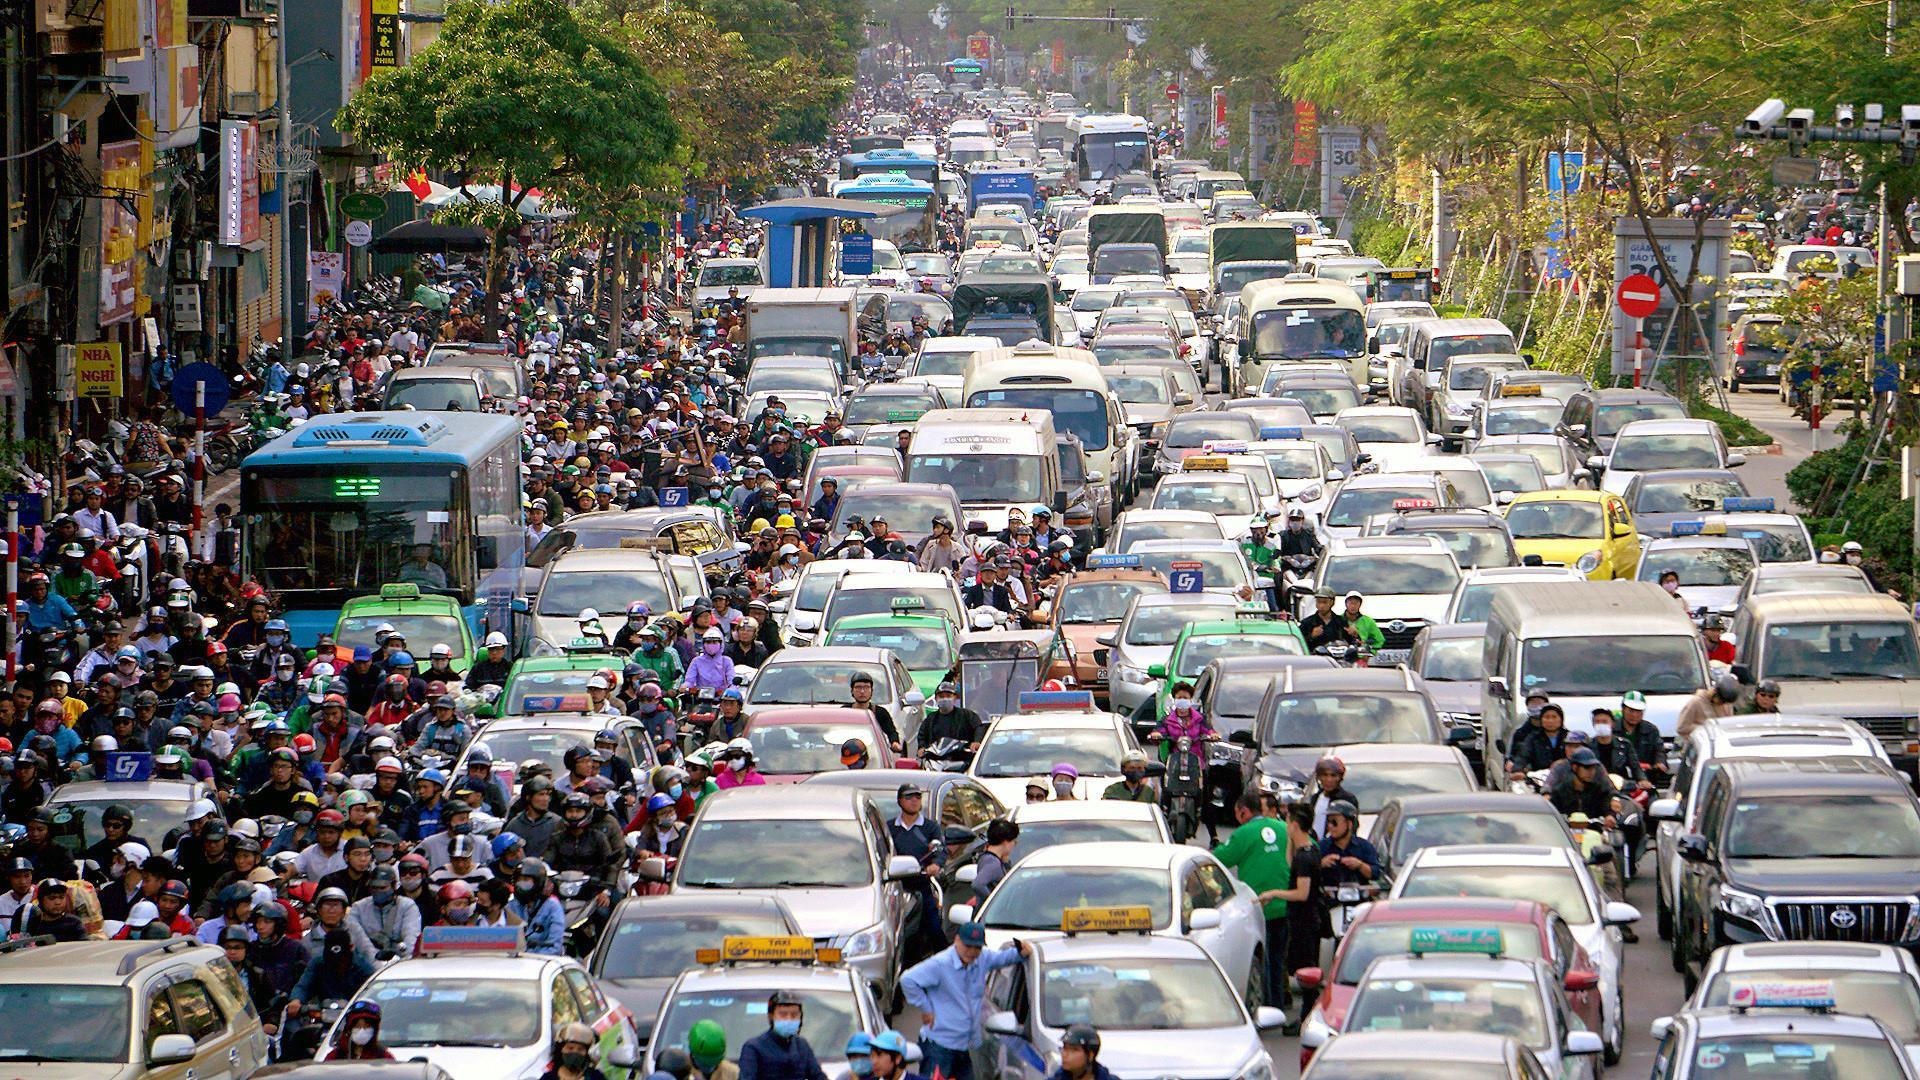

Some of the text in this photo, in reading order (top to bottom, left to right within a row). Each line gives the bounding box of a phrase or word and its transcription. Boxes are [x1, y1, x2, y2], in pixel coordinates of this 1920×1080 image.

[379, 35, 391, 48] &
[82, 345, 113, 361] NHÀ
[895, 598, 920, 606] TAXI
[768, 939, 792, 947] TAXI
